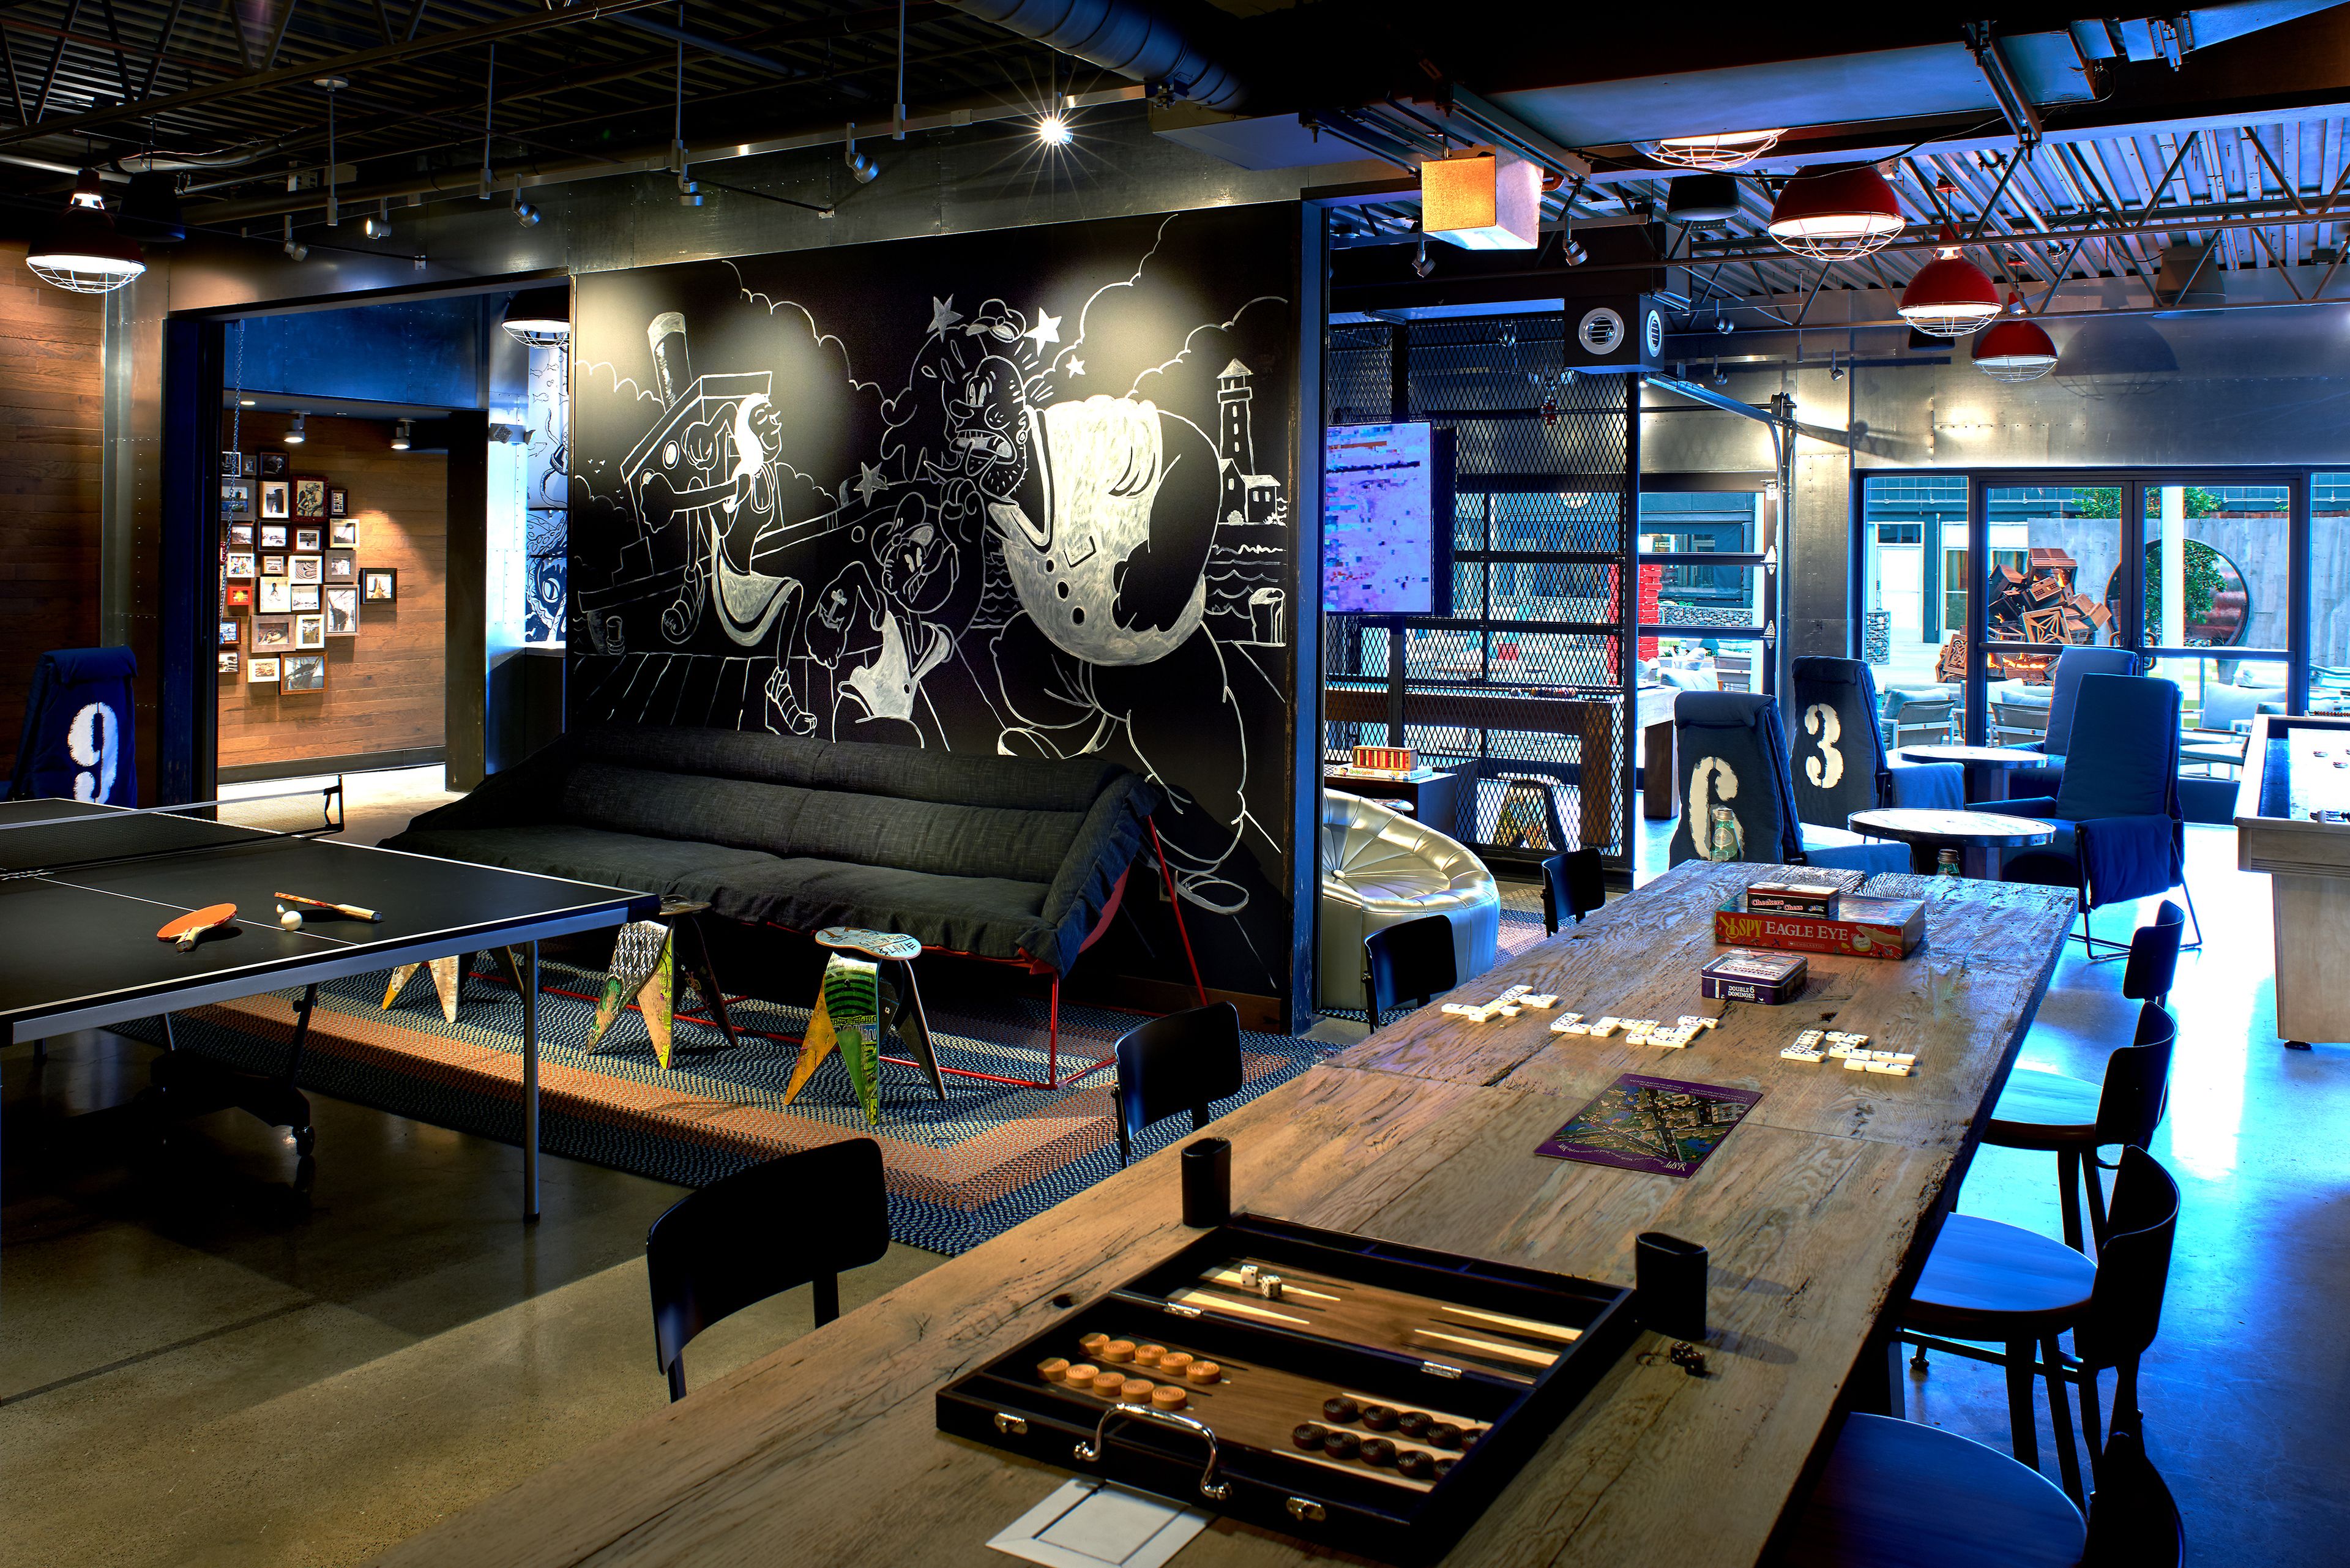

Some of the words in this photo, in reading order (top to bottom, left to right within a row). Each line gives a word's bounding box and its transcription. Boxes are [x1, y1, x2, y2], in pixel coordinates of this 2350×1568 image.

[67, 702, 118, 804] 9
[1804, 703, 1845, 789] 3
[1688, 756, 1745, 861] 6
[1739, 918, 1762, 938] SPY
[1765, 920, 1813, 938] EAGLE
[1817, 925, 1848, 941] EYE
[1728, 990, 1755, 999] DOMINOES
